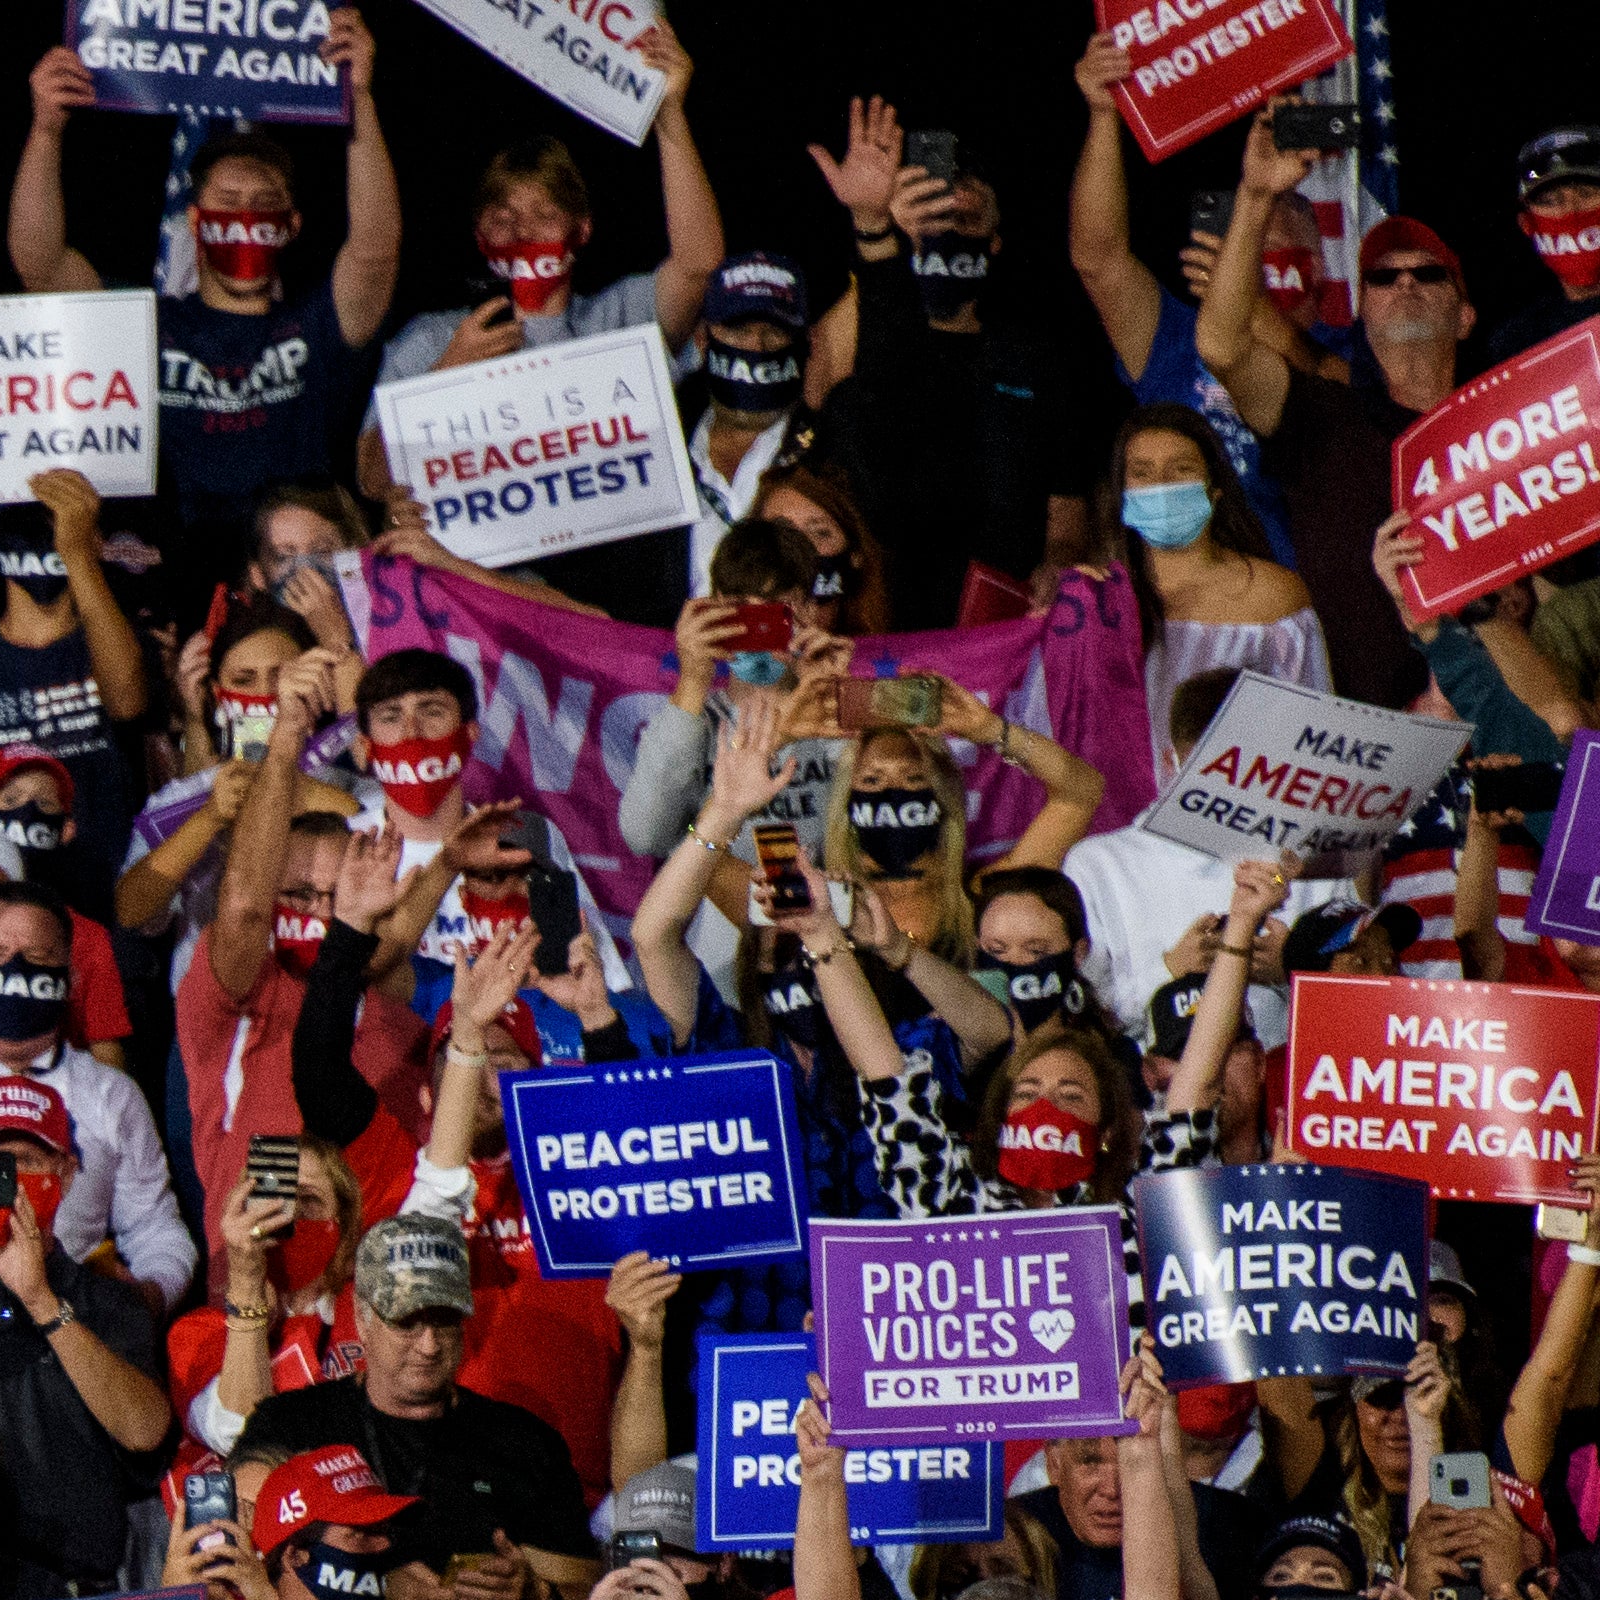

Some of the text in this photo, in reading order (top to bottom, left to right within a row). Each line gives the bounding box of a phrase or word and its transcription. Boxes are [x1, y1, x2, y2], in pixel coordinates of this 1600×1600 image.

[81, 0, 332, 42] AMERICA
[79, 39, 338, 87] GREAT AGAIN
[202, 221, 294, 248] MAGA
[419, 377, 639, 451] THIS IS A
[1448, 386, 1586, 480] MORE
[23, 424, 142, 456] AGAIN
[423, 415, 648, 488] PEACEFUL
[431, 452, 654, 532] PROTEST
[369, 755, 464, 784] MAGA
[1296, 726, 1392, 769] MAKE
[1199, 745, 1411, 821] AMERICA
[850, 800, 939, 829] MAGA
[1178, 789, 1289, 851] GREAT
[1386, 1014, 1508, 1054] MAKE
[1302, 1055, 1584, 1118] AMERICA
[536, 1117, 769, 1172] PEACEFUL
[1301, 1113, 1582, 1161] GREAT AGAIN
[548, 1171, 775, 1222] PROTESTER
[1223, 1201, 1342, 1234] MAKE
[862, 1252, 1073, 1315] PRO-LIFE
[1156, 1244, 1419, 1303] AMERICA
[863, 1312, 1019, 1364] VOICES
[1158, 1301, 1419, 1349] GREAT AGAIN
[872, 1369, 1075, 1401] FOR TRUMP
[955, 1421, 997, 1434] 2020
[278, 1492, 308, 1525] 45
